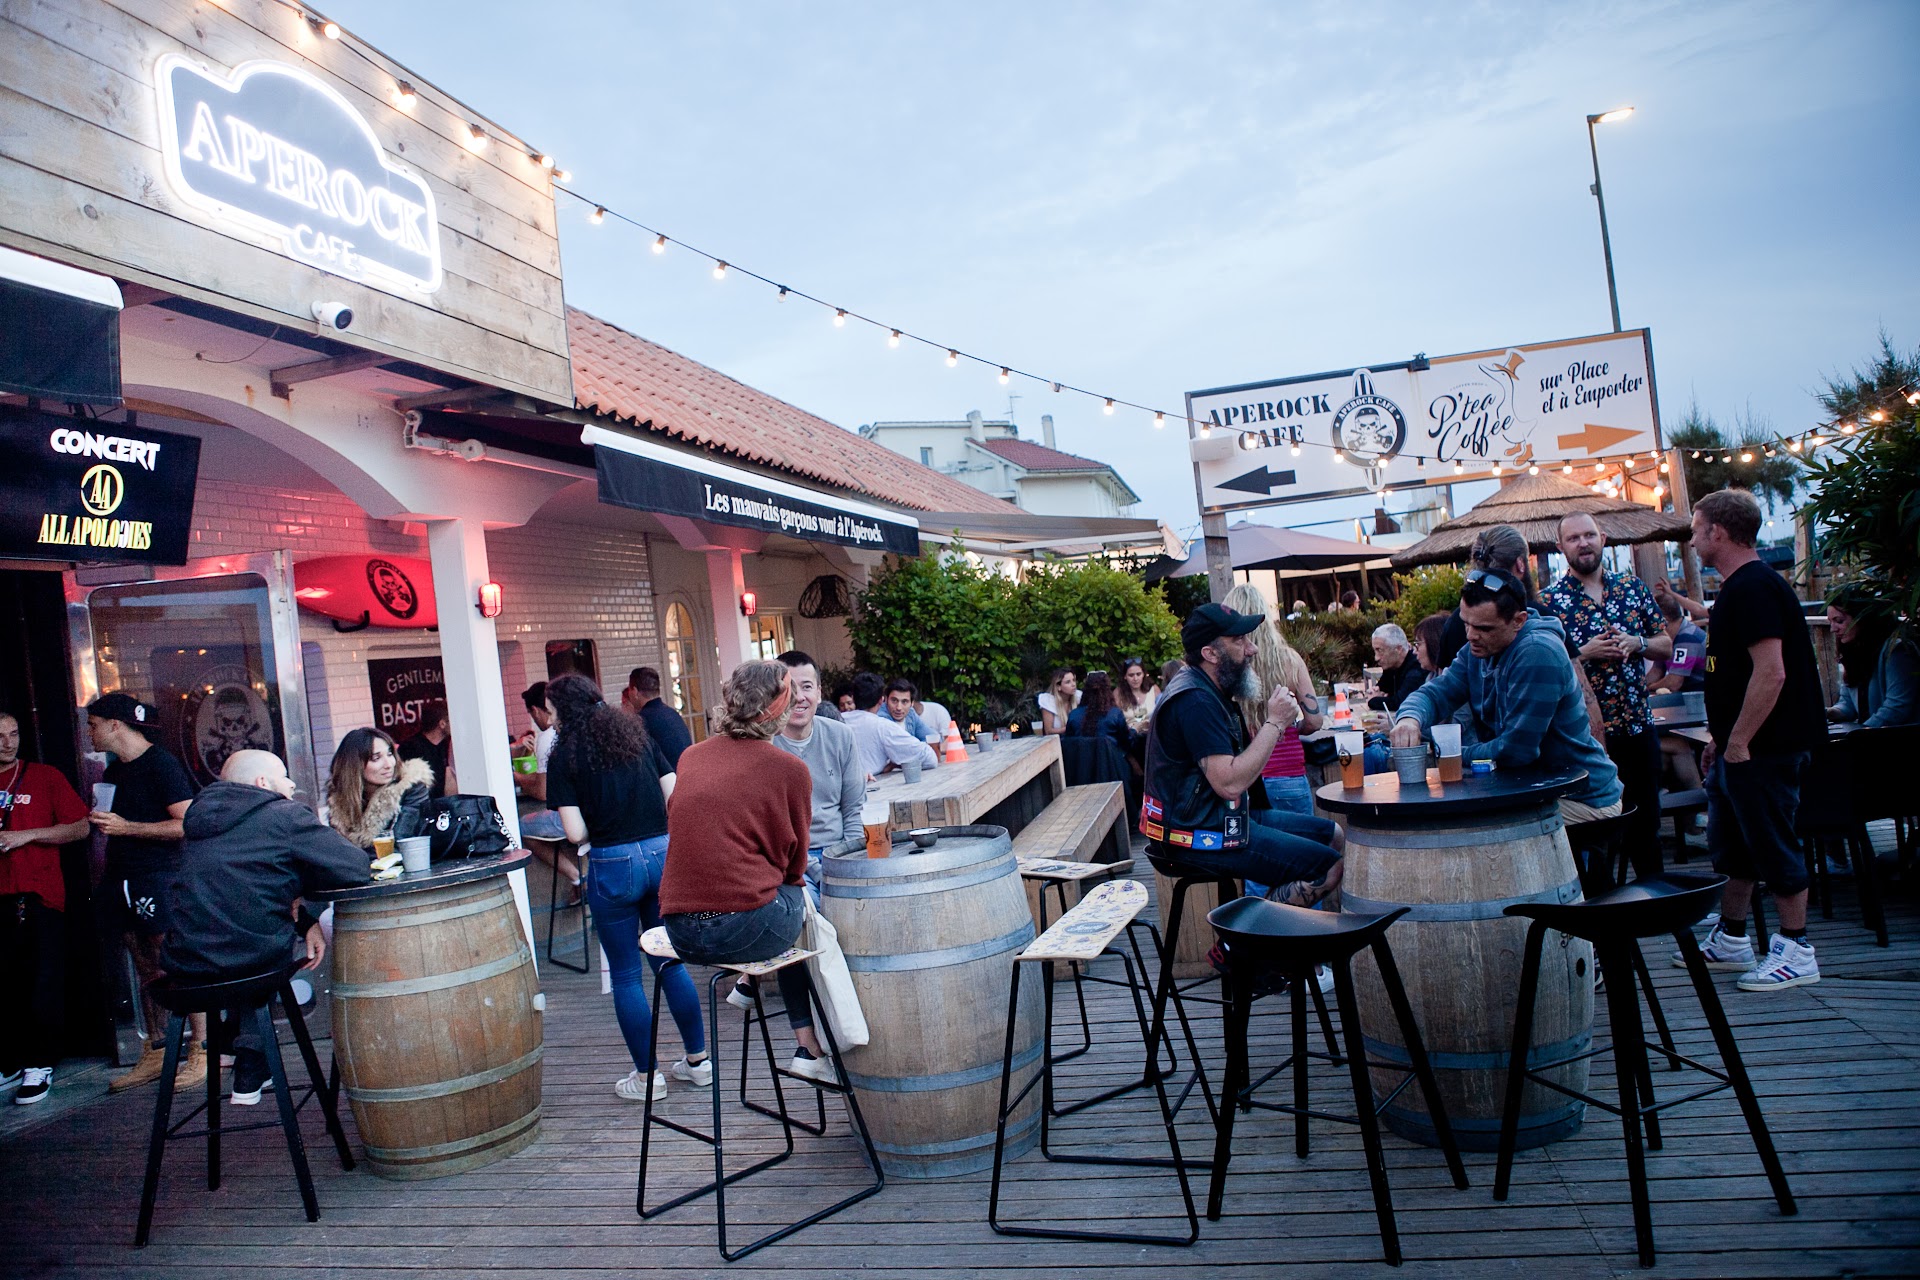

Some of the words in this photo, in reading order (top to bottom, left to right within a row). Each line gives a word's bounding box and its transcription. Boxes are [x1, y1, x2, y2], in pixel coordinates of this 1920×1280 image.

[184, 101, 432, 258] APEROCK
[1540, 374, 1562, 392] sur
[1567, 360, 1609, 383] Place
[1542, 392, 1555, 414] et
[1559, 391, 1569, 410] à
[1575, 373, 1643, 409] Emporter
[1209, 393, 1331, 428] APEROCK
[1339, 397, 1374, 420] APEROCK
[1376, 398, 1396, 413] CAFE
[1428, 392, 1496, 438] P'tea
[50, 428, 160, 471] CONCERT
[1239, 425, 1305, 450] CAFE
[1437, 412, 1515, 463] Coffee
[705, 484, 730, 512] Les
[731, 498, 780, 523] mauvais
[780, 508, 818, 533] garçons
[818, 517, 836, 535] vont
[837, 515, 844, 536] à
[37, 514, 70, 544] ALL
[70, 516, 152, 550] APOLOGIES
[1675, 650, 1685, 662] P
[386, 669, 445, 693] GENTLEM
